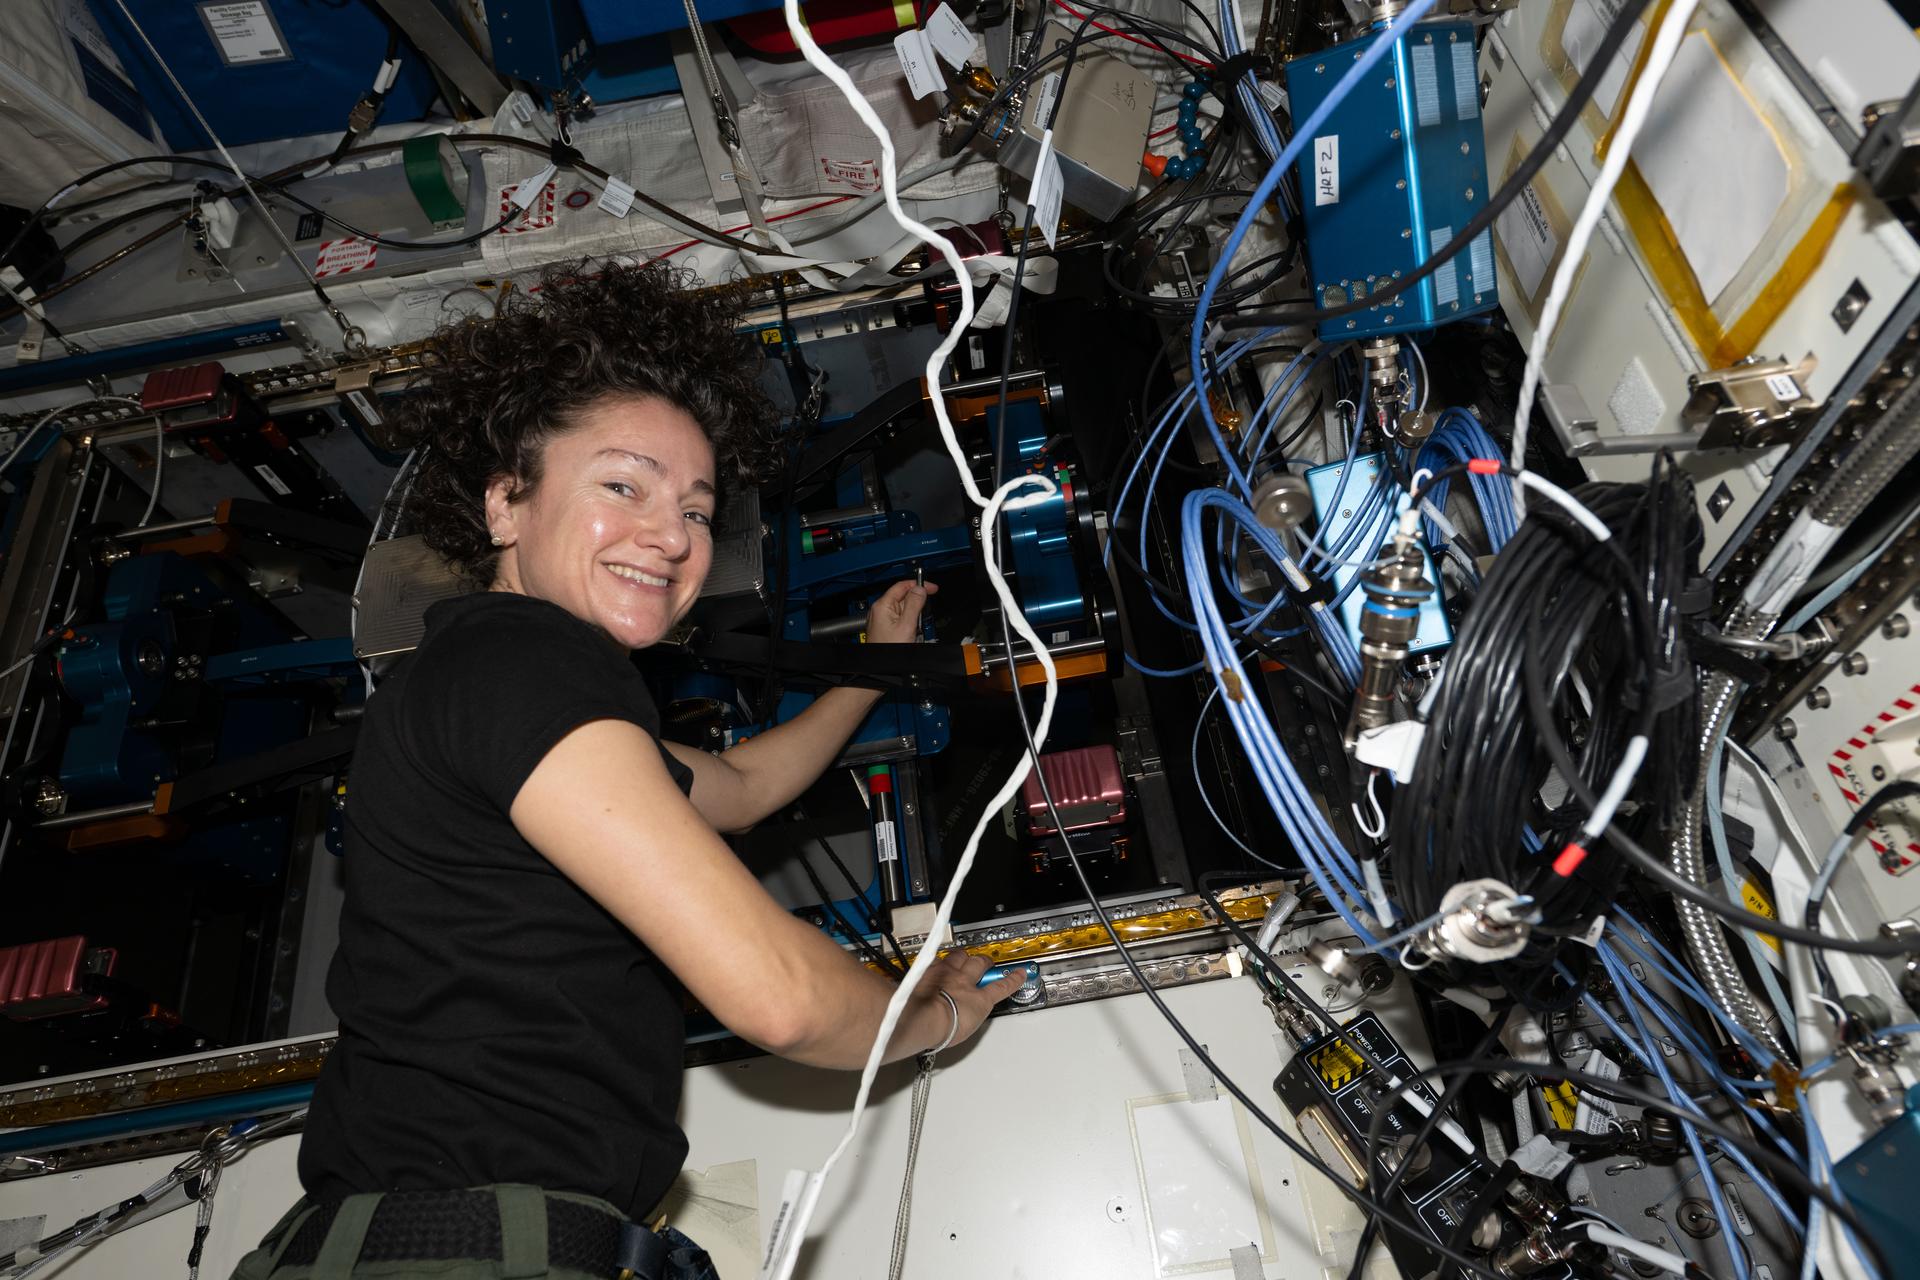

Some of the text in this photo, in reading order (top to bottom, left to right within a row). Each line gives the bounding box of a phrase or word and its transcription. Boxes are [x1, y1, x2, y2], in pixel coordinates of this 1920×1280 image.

[838, 170, 865, 180] FIRE
[1320, 166, 1335, 197] HRF
[326, 250, 368, 262] BREATHING
[326, 259, 366, 270] APPARATUS
[1843, 764, 1867, 801] RACK
[1749, 896, 1764, 911] P/N
[1352, 1027, 1381, 1063] POWER ON
[1353, 1097, 1370, 1117] OFF
[1437, 1208, 1455, 1227] OFF
